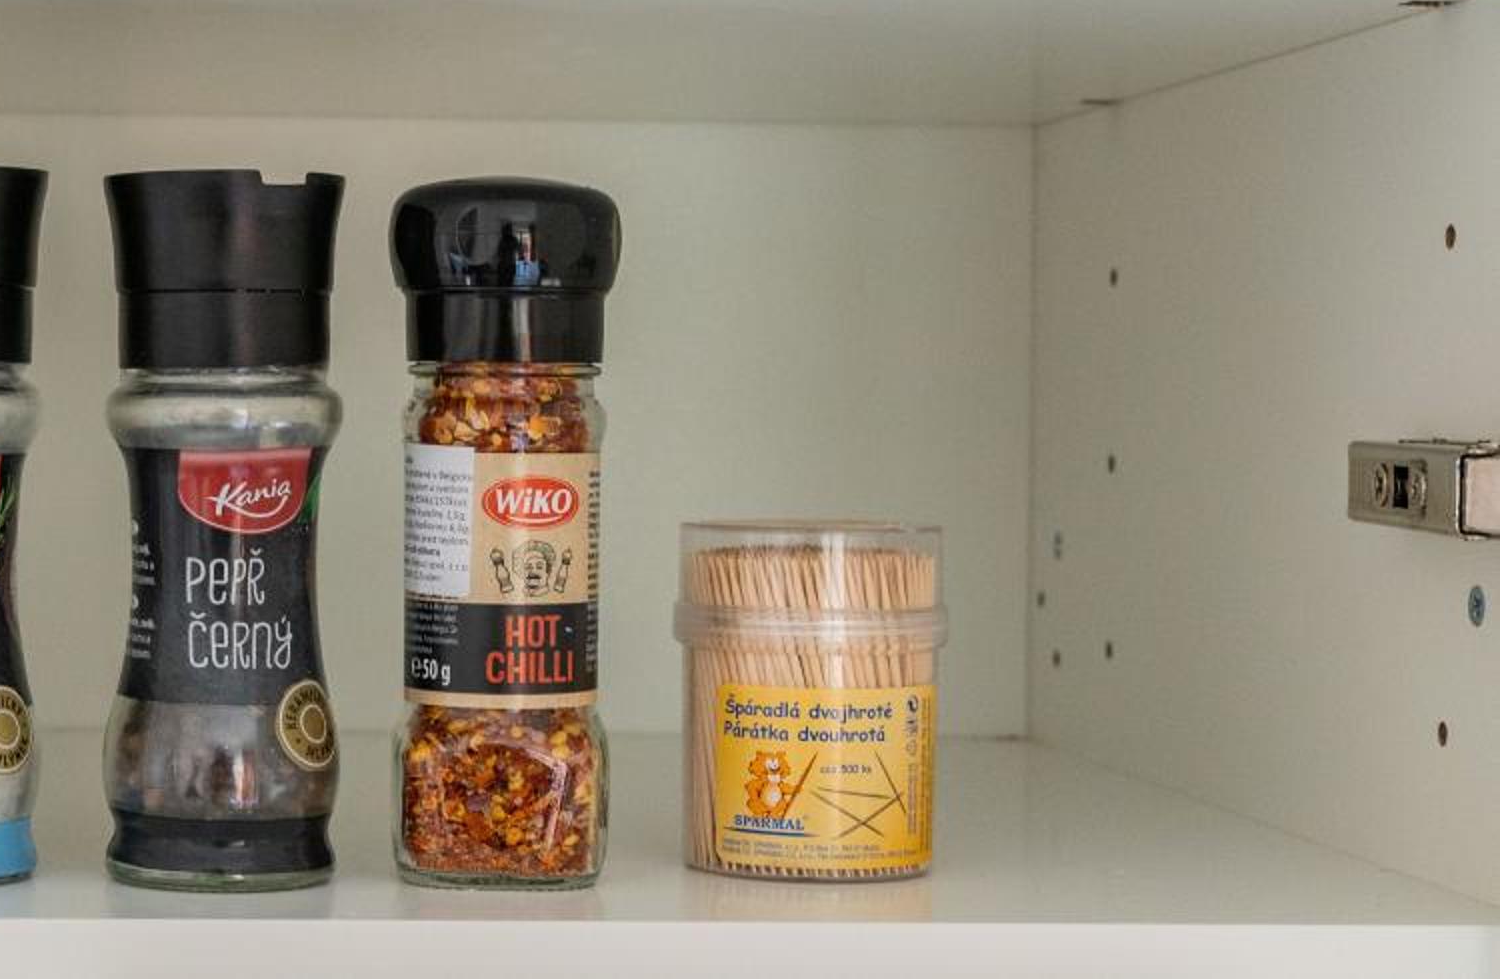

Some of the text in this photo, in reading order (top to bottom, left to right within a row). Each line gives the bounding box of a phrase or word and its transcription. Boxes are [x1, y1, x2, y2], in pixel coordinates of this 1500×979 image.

[207, 478, 292, 518] Kania
[505, 615, 561, 648] HOT
[485, 652, 574, 684] CHILLI
[724, 693, 894, 724] Špáradlá dvojhroté
[722, 720, 886, 743] Párátka dvouhrotá
